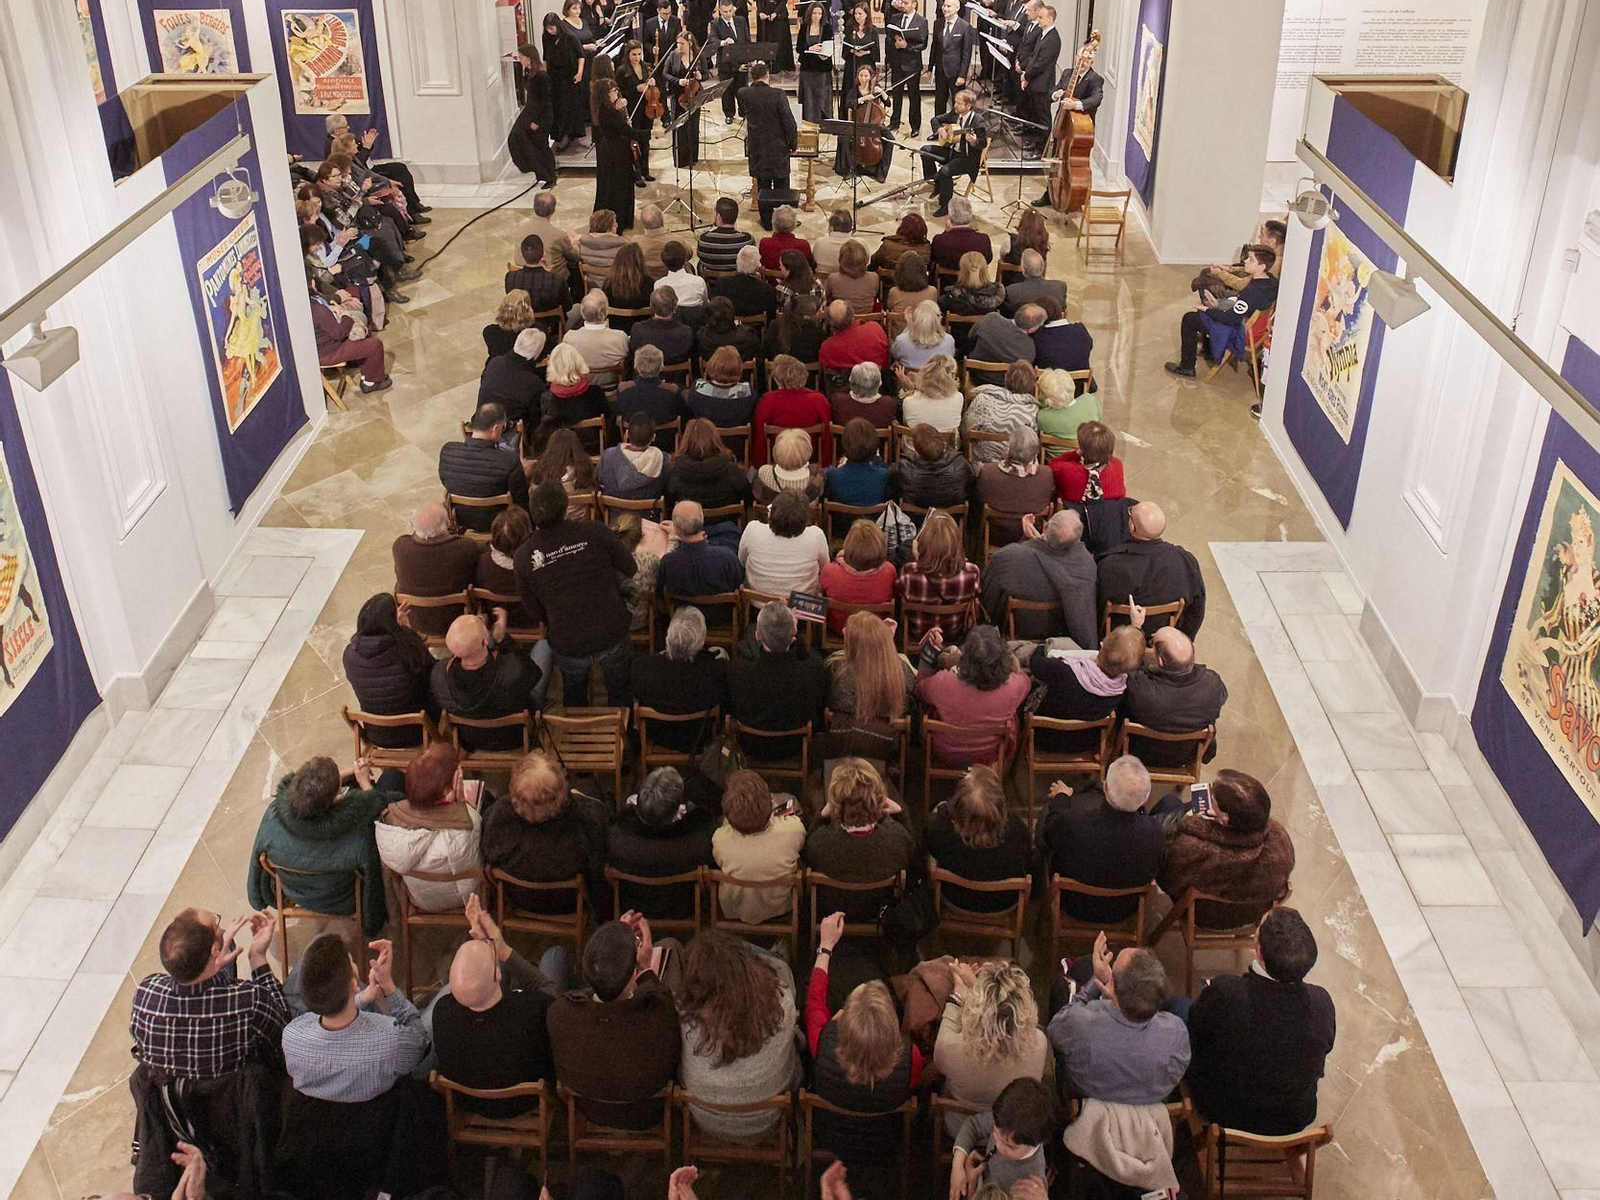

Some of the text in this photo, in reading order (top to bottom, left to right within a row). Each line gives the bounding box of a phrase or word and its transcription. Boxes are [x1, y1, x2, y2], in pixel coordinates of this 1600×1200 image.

[159, 12, 192, 34] FOLIES
[1520, 691, 1597, 800] SE VEND PARTOUT
[1546, 663, 1600, 784] Savo
